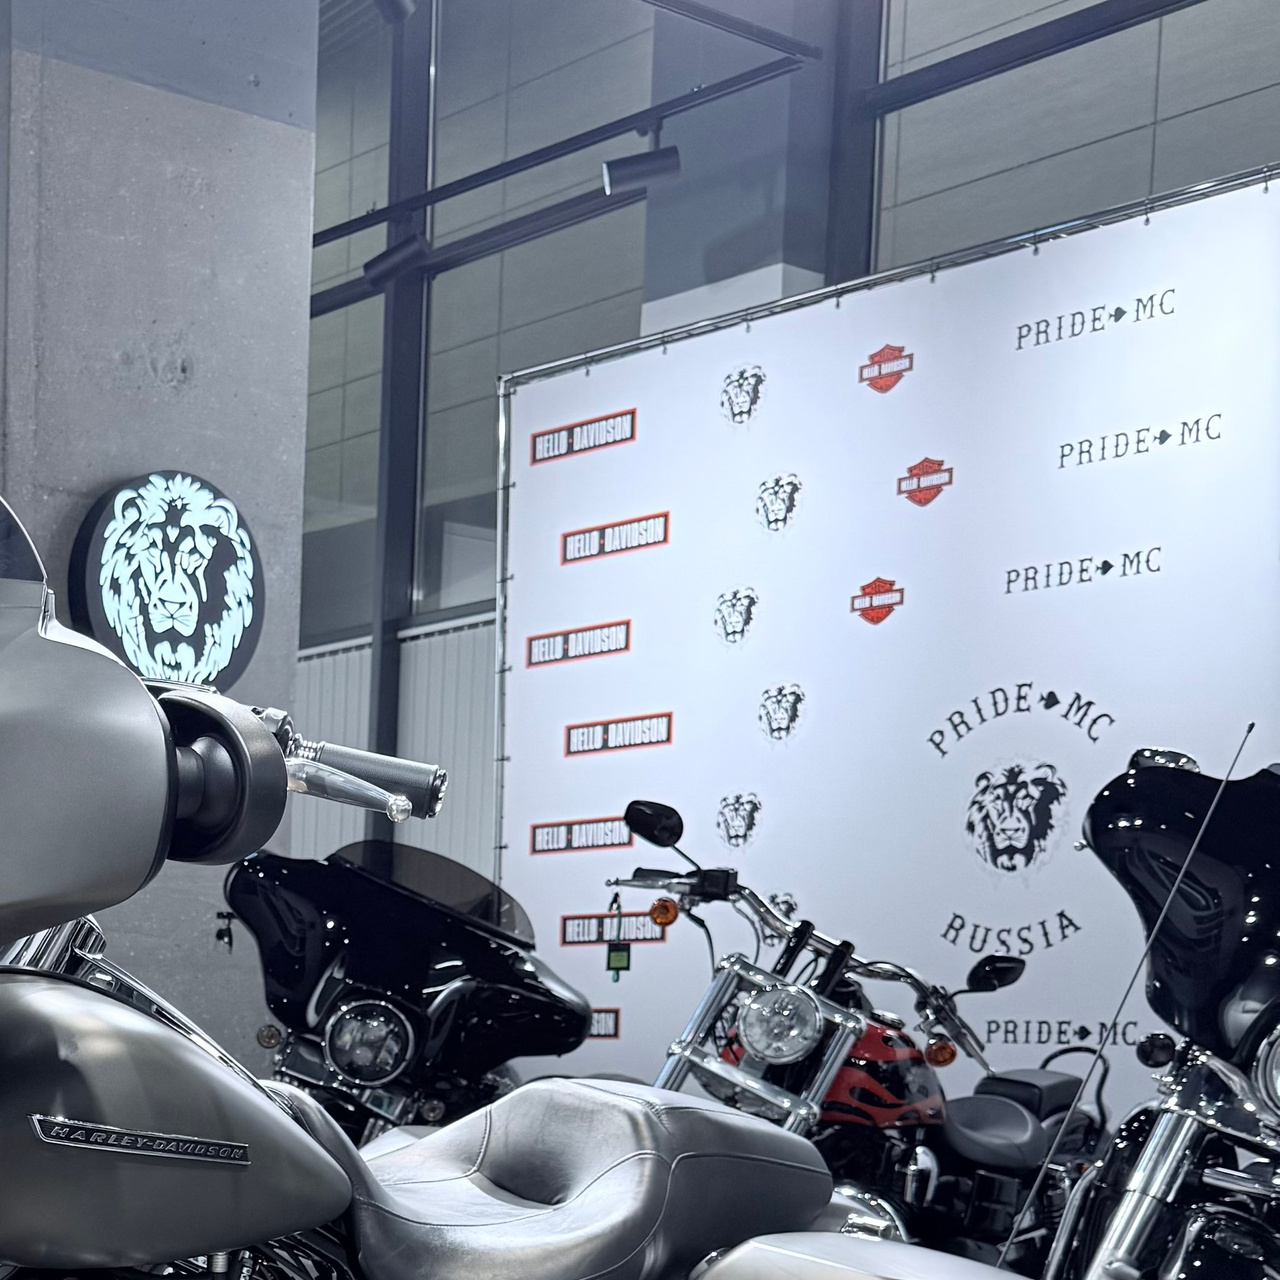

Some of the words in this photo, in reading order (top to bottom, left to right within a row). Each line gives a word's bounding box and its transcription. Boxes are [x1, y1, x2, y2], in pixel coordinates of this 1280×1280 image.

[1015, 304, 1106, 351] PRIDE
[1133, 288, 1175, 323] MC
[535, 430, 568, 460] HELLO
[573, 413, 632, 451] DAVIDSON
[1058, 426, 1150, 469] PRIDE
[1178, 414, 1222, 447] MC
[565, 530, 600, 560] HELLO
[604, 516, 666, 553] DAVIDSON
[1004, 556, 1093, 594] PRIDE
[1119, 546, 1161, 577] MC
[531, 635, 563, 663] HELLO
[567, 624, 627, 658] DAVIDSON
[569, 725, 603, 752] HELLO
[607, 716, 669, 748] DAVIDSON
[926, 682, 1033, 758] PRIDE
[1060, 692, 1115, 744] MC
[940, 909, 1081, 955] RUSSIA
[986, 1020, 1071, 1045] PRIDE
[1098, 1021, 1138, 1046] MC
[50, 1126, 243, 1159] HARLEY-DAVIDSON
